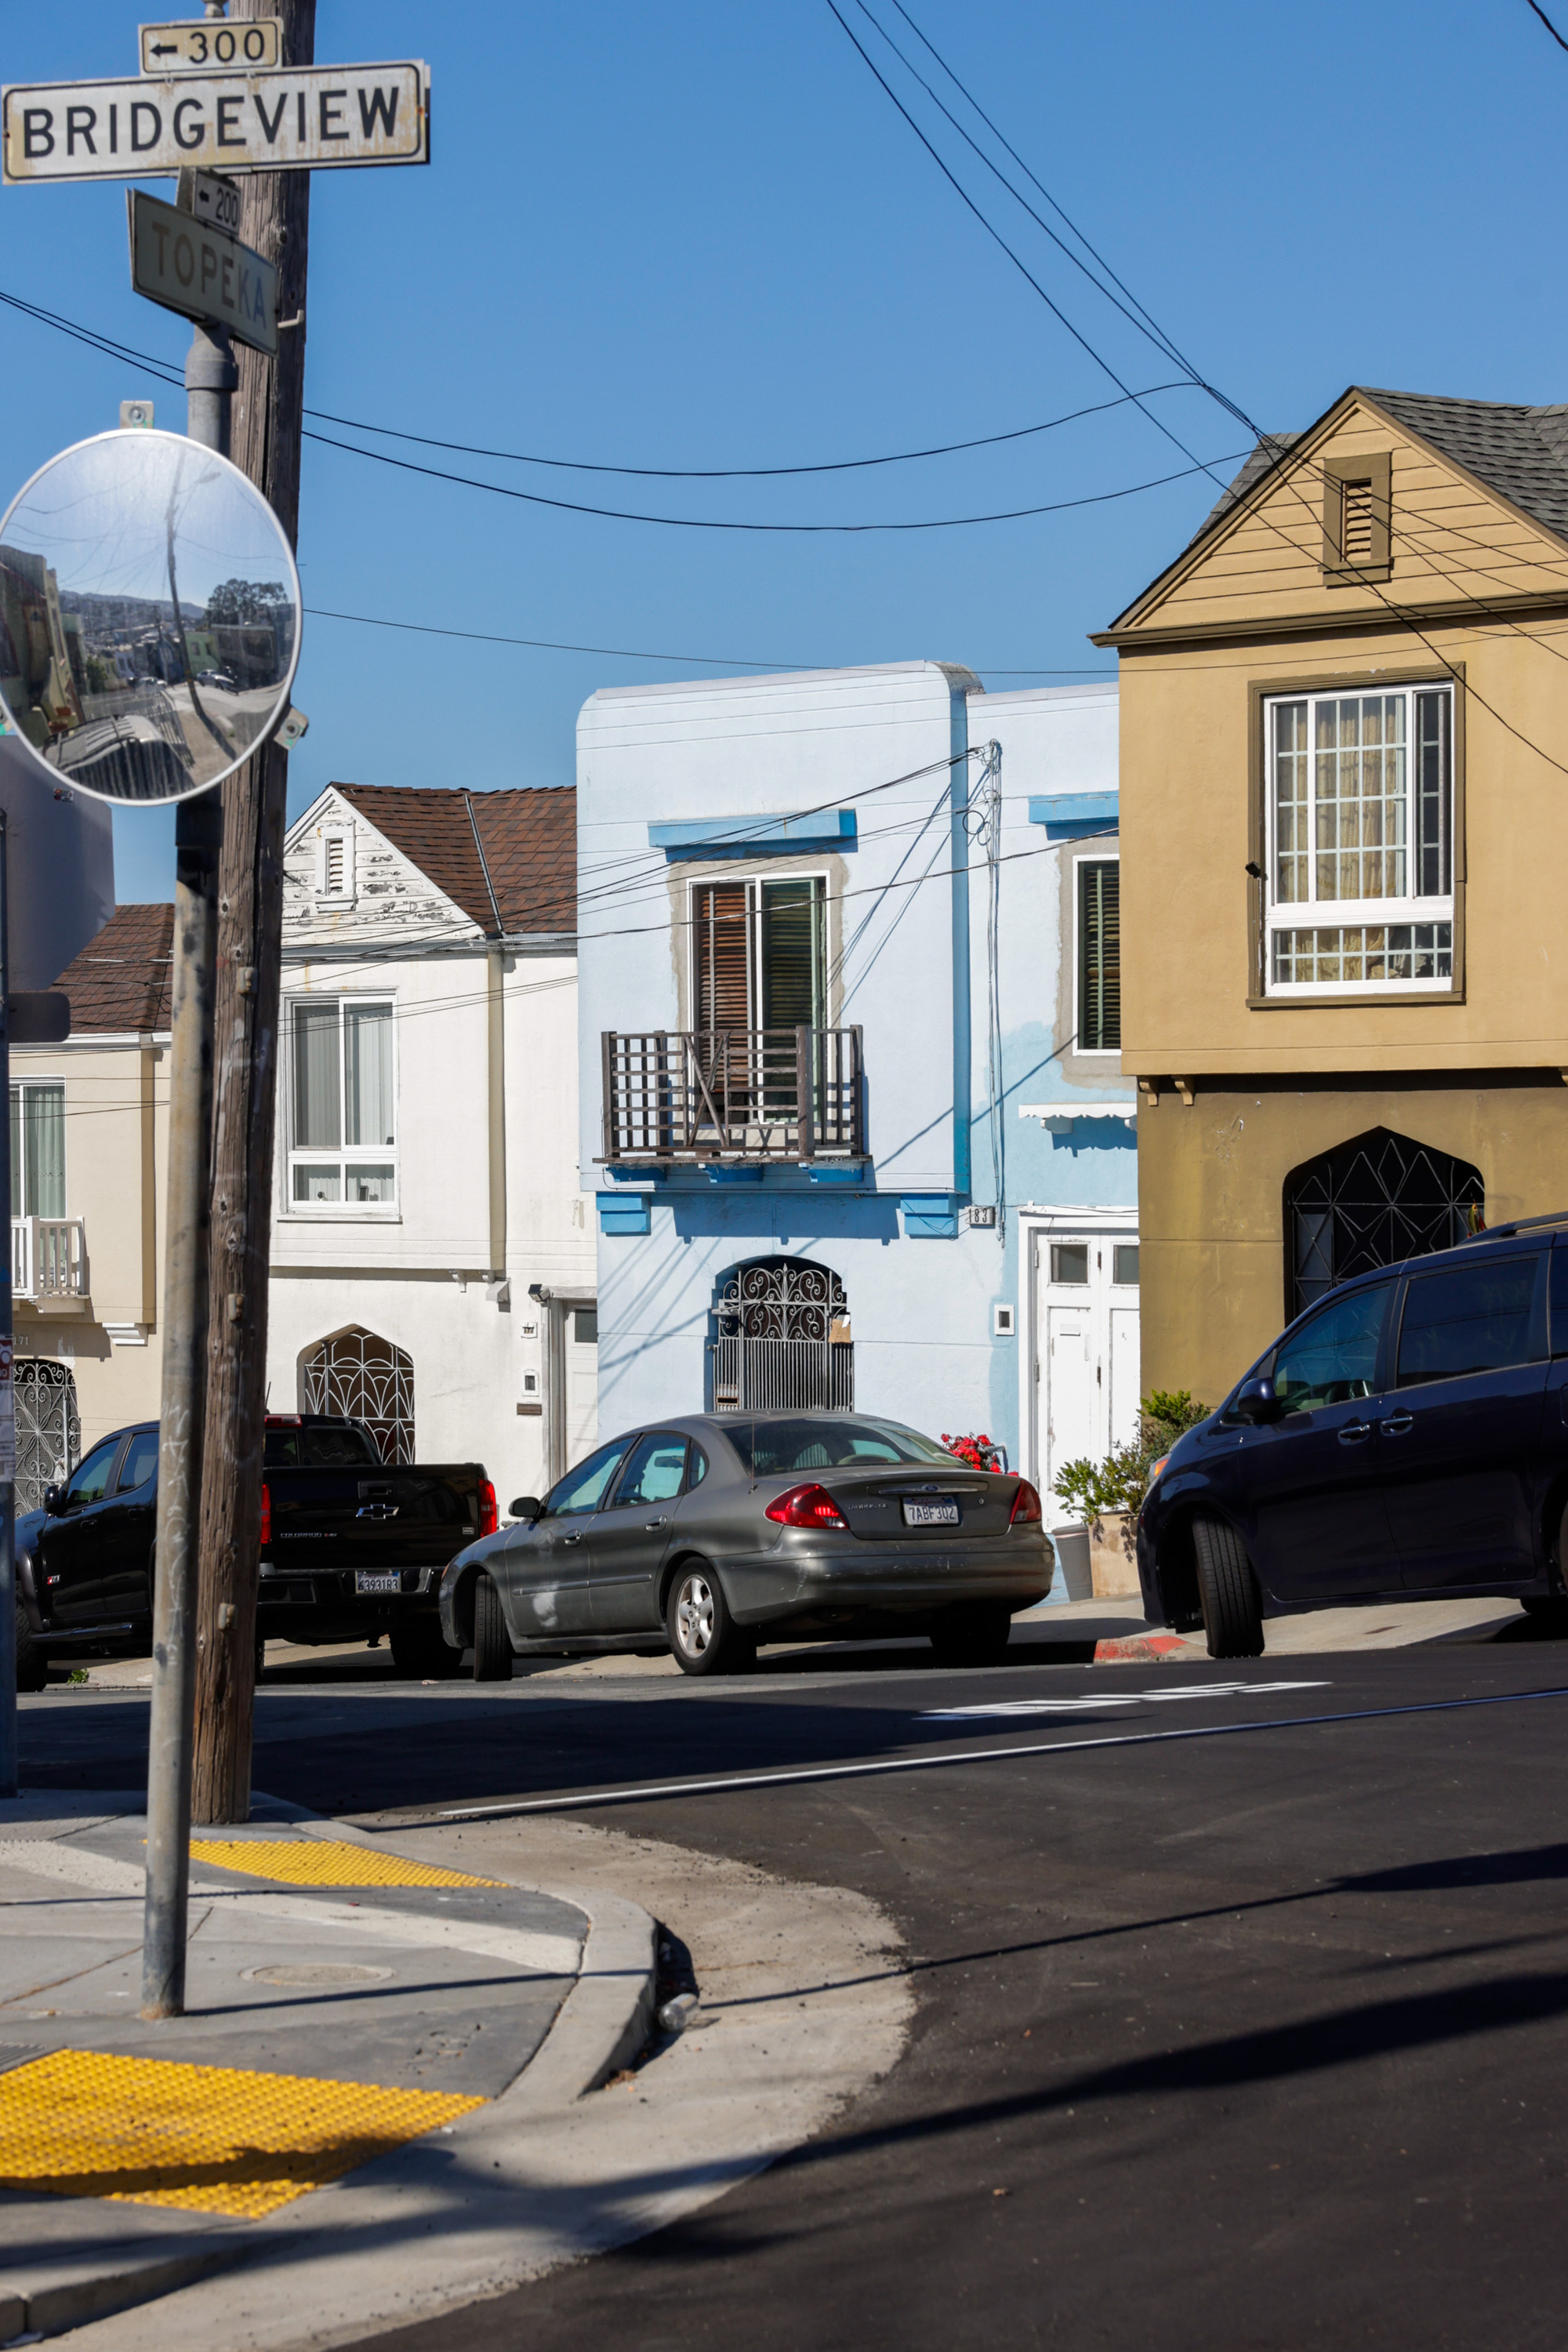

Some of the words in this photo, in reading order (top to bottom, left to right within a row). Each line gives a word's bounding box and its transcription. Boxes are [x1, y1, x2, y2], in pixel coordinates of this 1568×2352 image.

[189, 29, 265, 64] 300
[23, 87, 399, 159] BRIDGEVIEW
[216, 186, 239, 227] 200
[152, 221, 267, 330] TOPEKA
[968, 1208, 987, 1223] 183
[909, 1506, 955, 1520] 7ABF302
[358, 1579, 397, 1590] 63931R3
